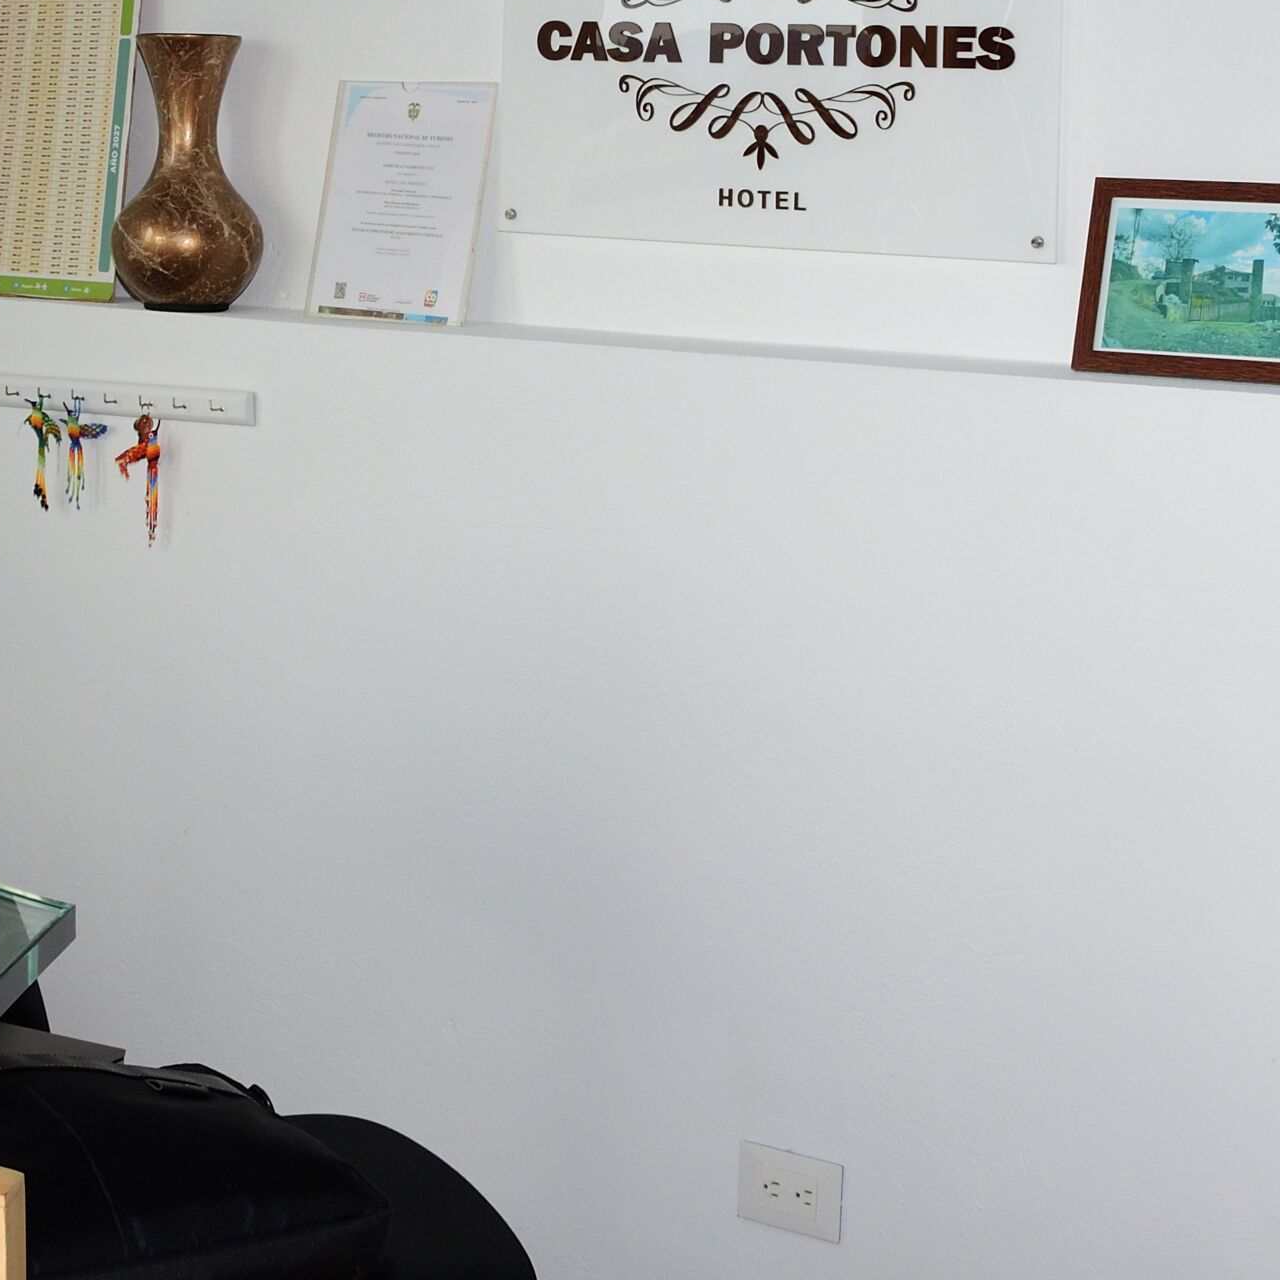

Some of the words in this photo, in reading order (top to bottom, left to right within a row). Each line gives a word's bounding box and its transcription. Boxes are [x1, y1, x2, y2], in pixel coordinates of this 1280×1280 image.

[537, 20, 683, 64] CASA
[709, 23, 1016, 71] PORTONES
[112, 124, 120, 148] 2027
[718, 188, 807, 211] HOTEL
